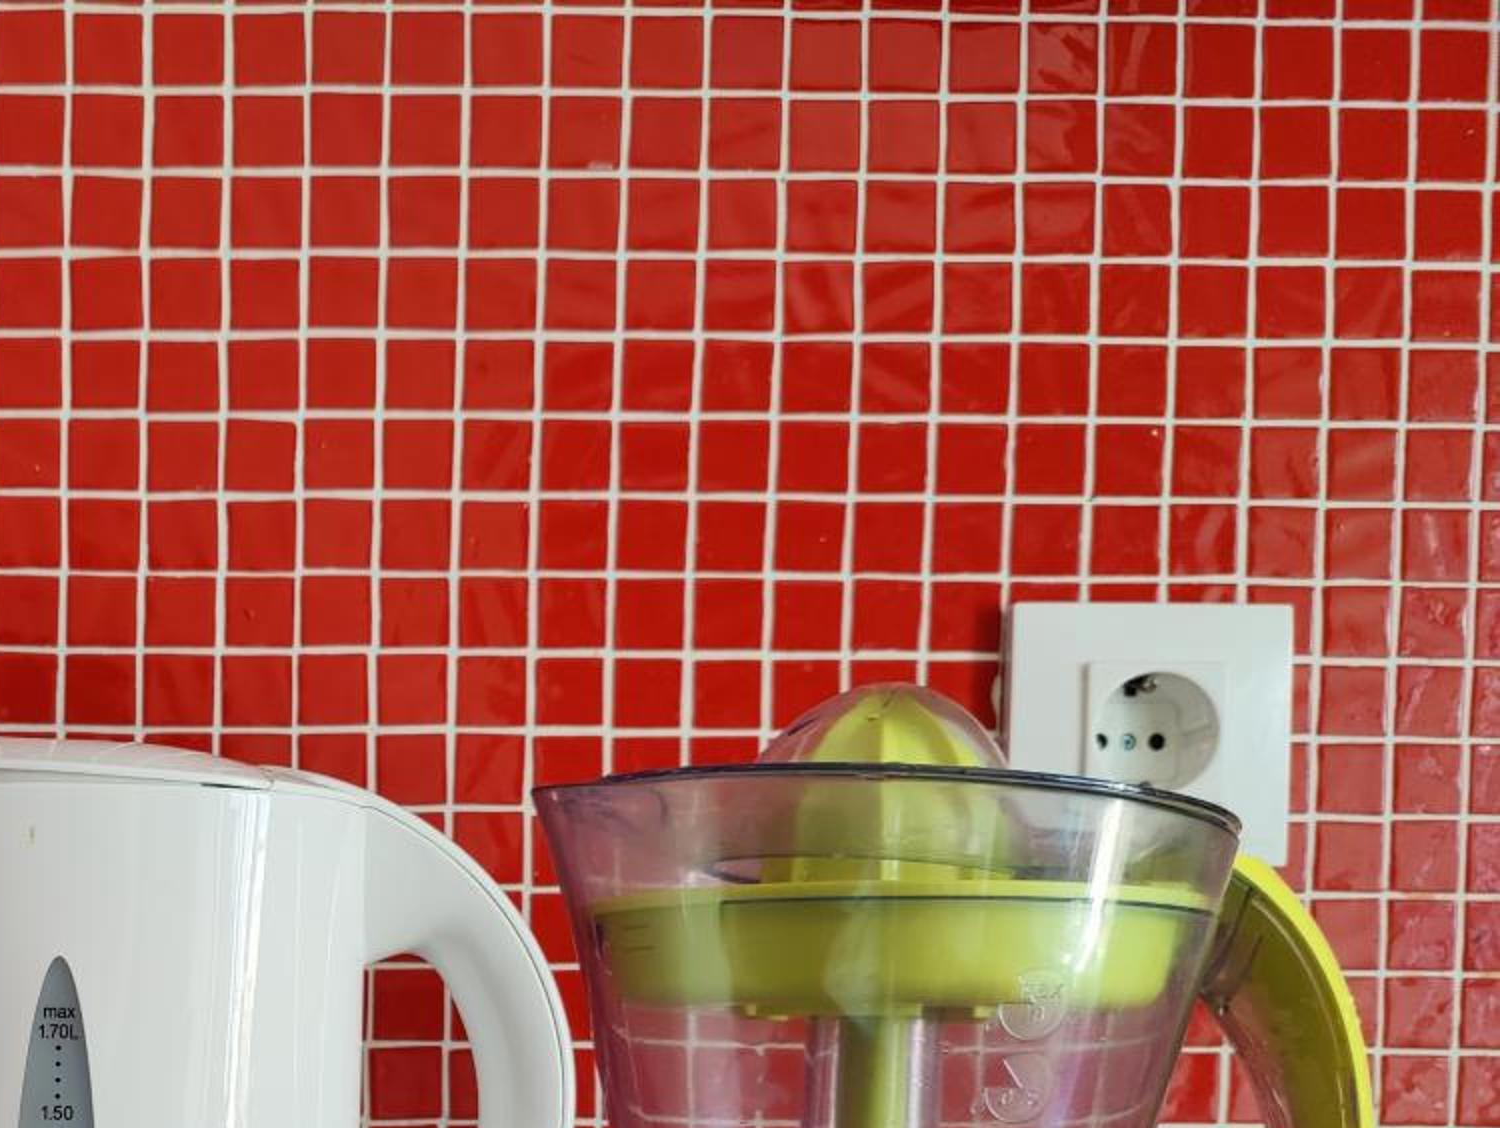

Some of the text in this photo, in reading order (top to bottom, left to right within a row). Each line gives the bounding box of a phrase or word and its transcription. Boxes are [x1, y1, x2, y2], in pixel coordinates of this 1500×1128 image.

[43, 1007, 75, 1019] max
[38, 1023, 79, 1040] 1.70L
[41, 1105, 74, 1121] 1.50
